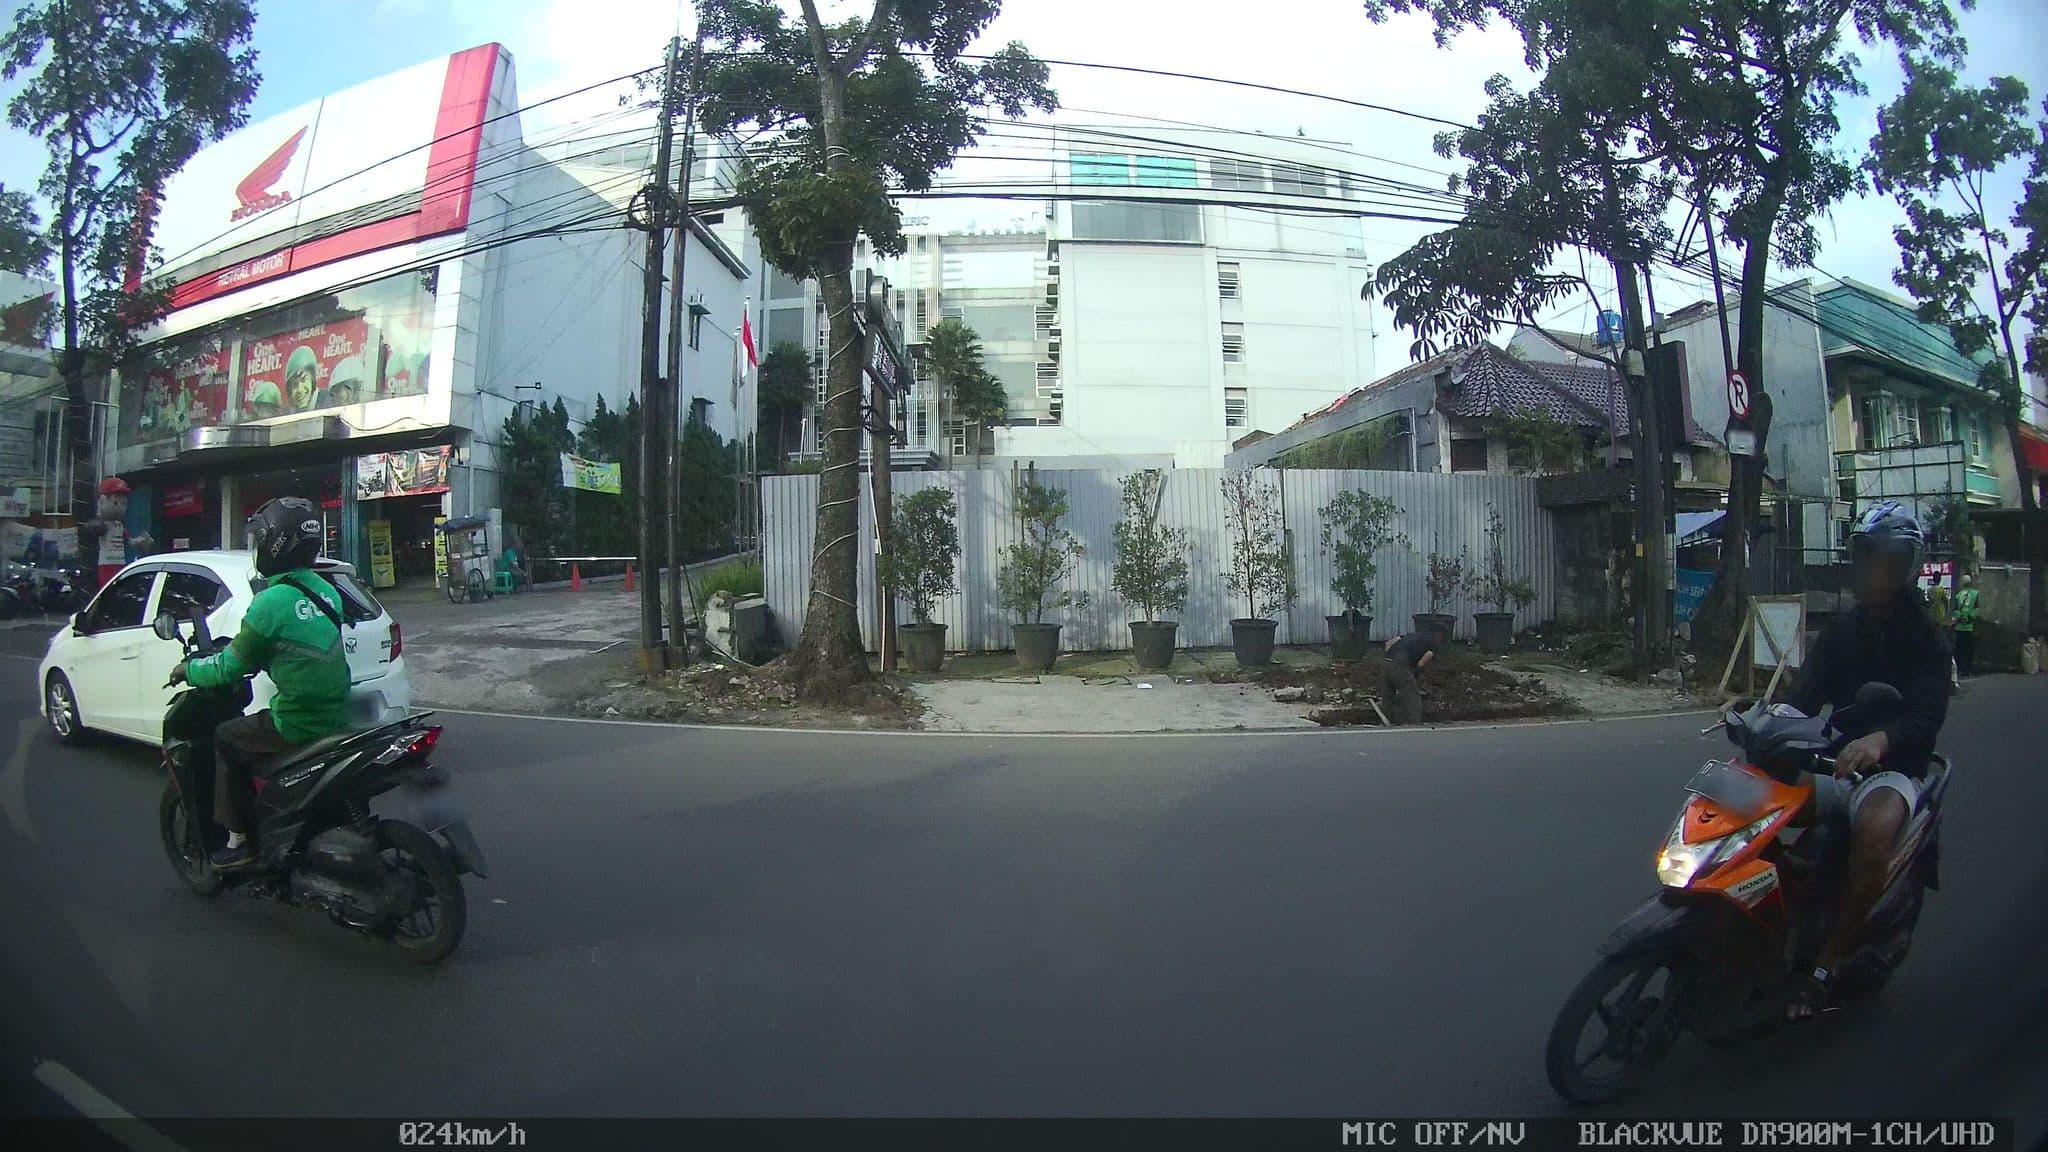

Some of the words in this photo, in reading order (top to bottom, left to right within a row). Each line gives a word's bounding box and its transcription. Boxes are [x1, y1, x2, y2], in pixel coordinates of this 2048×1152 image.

[230, 190, 293, 222] HONDA
[252, 254, 285, 276] MOTOR
[328, 333, 346, 346] One
[253, 342, 277, 359] One
[246, 352, 283, 377] HEART.
[1738, 872, 1774, 893] HONDA
